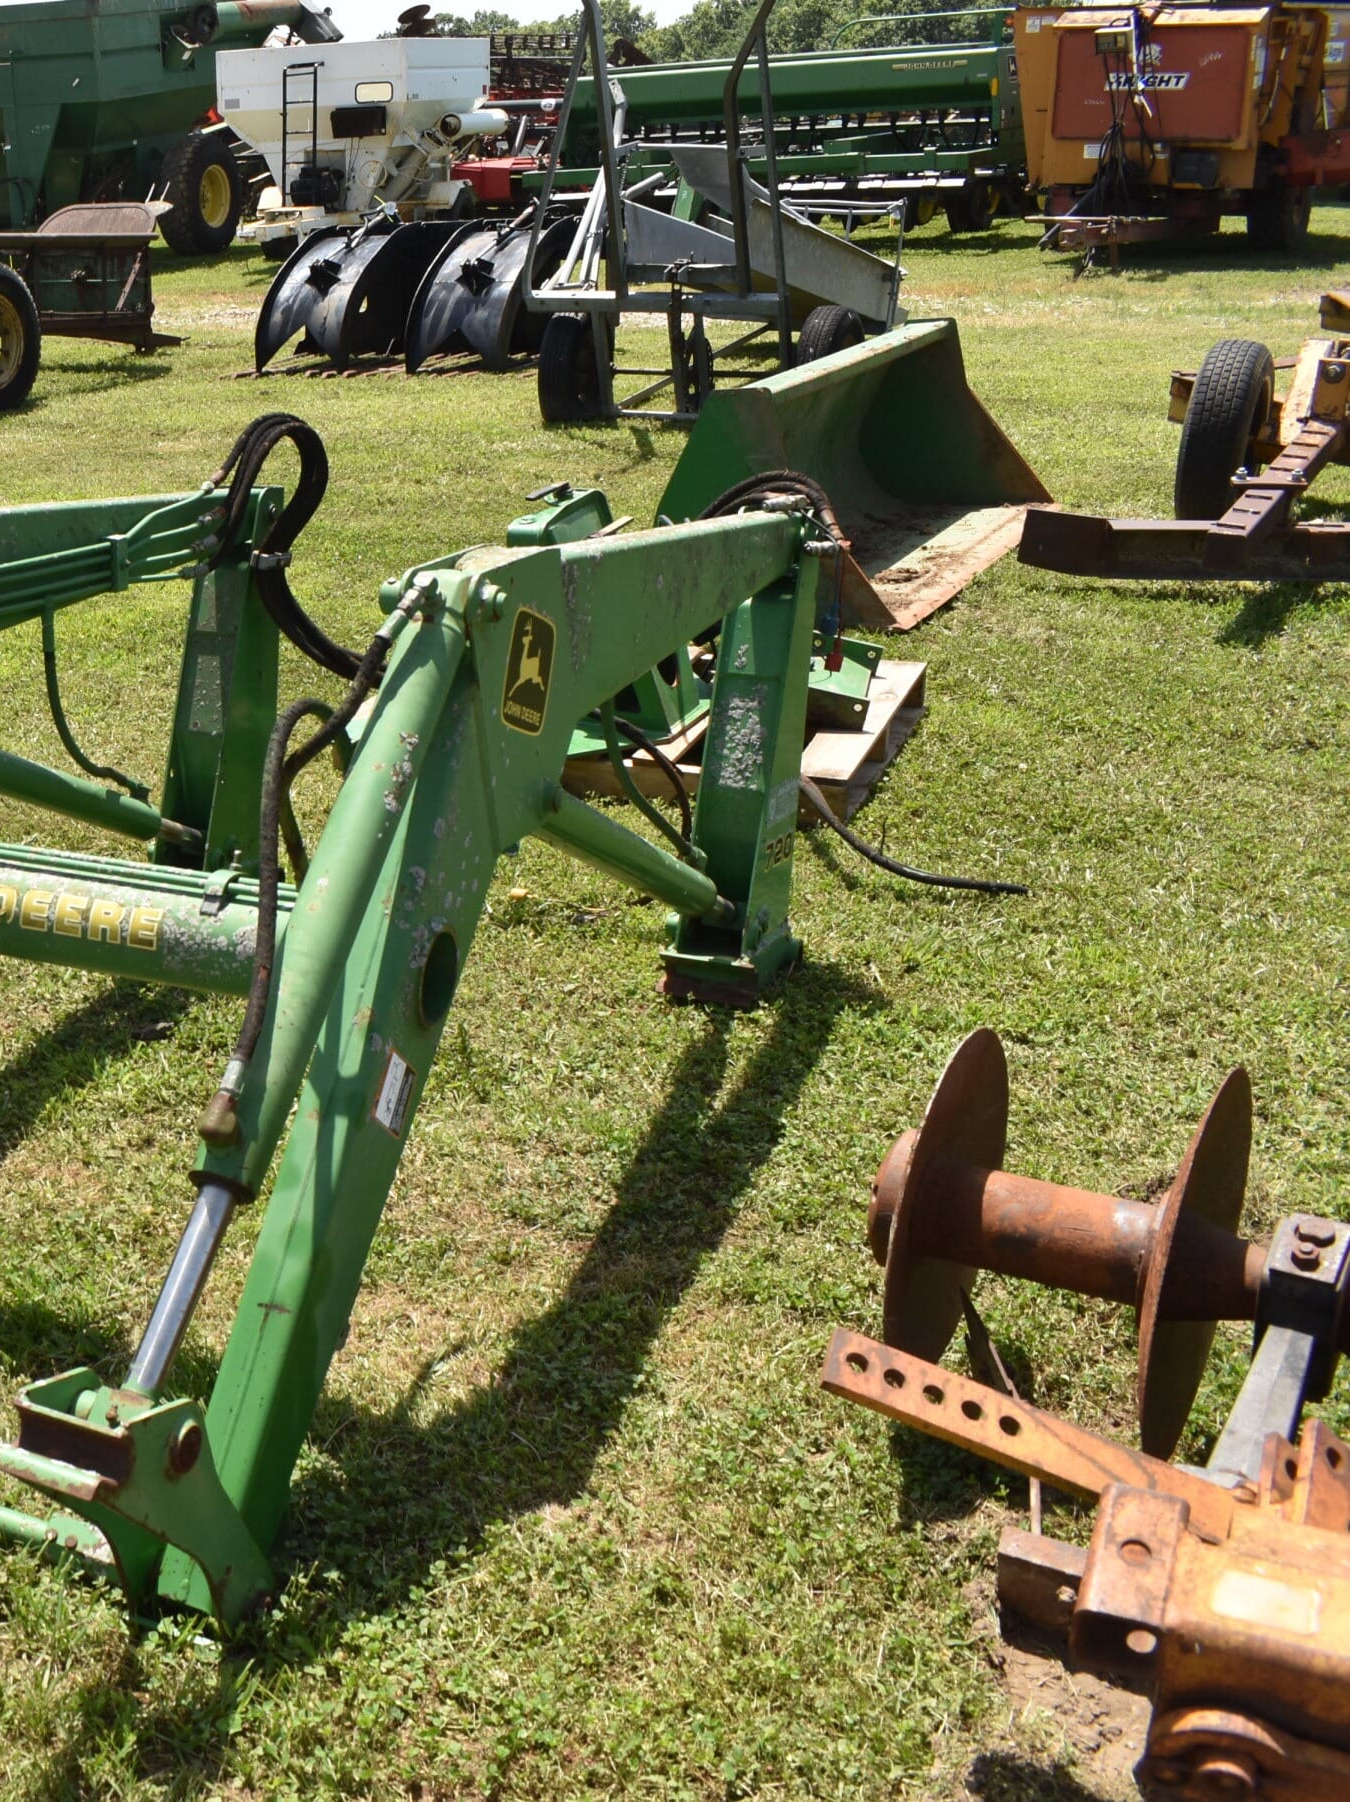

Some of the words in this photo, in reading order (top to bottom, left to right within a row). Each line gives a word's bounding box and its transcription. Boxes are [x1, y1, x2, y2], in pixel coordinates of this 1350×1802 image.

[504, 700, 523, 719] JOHN
[521, 705, 541, 727] DEERE
[763, 831, 793, 873] 720
